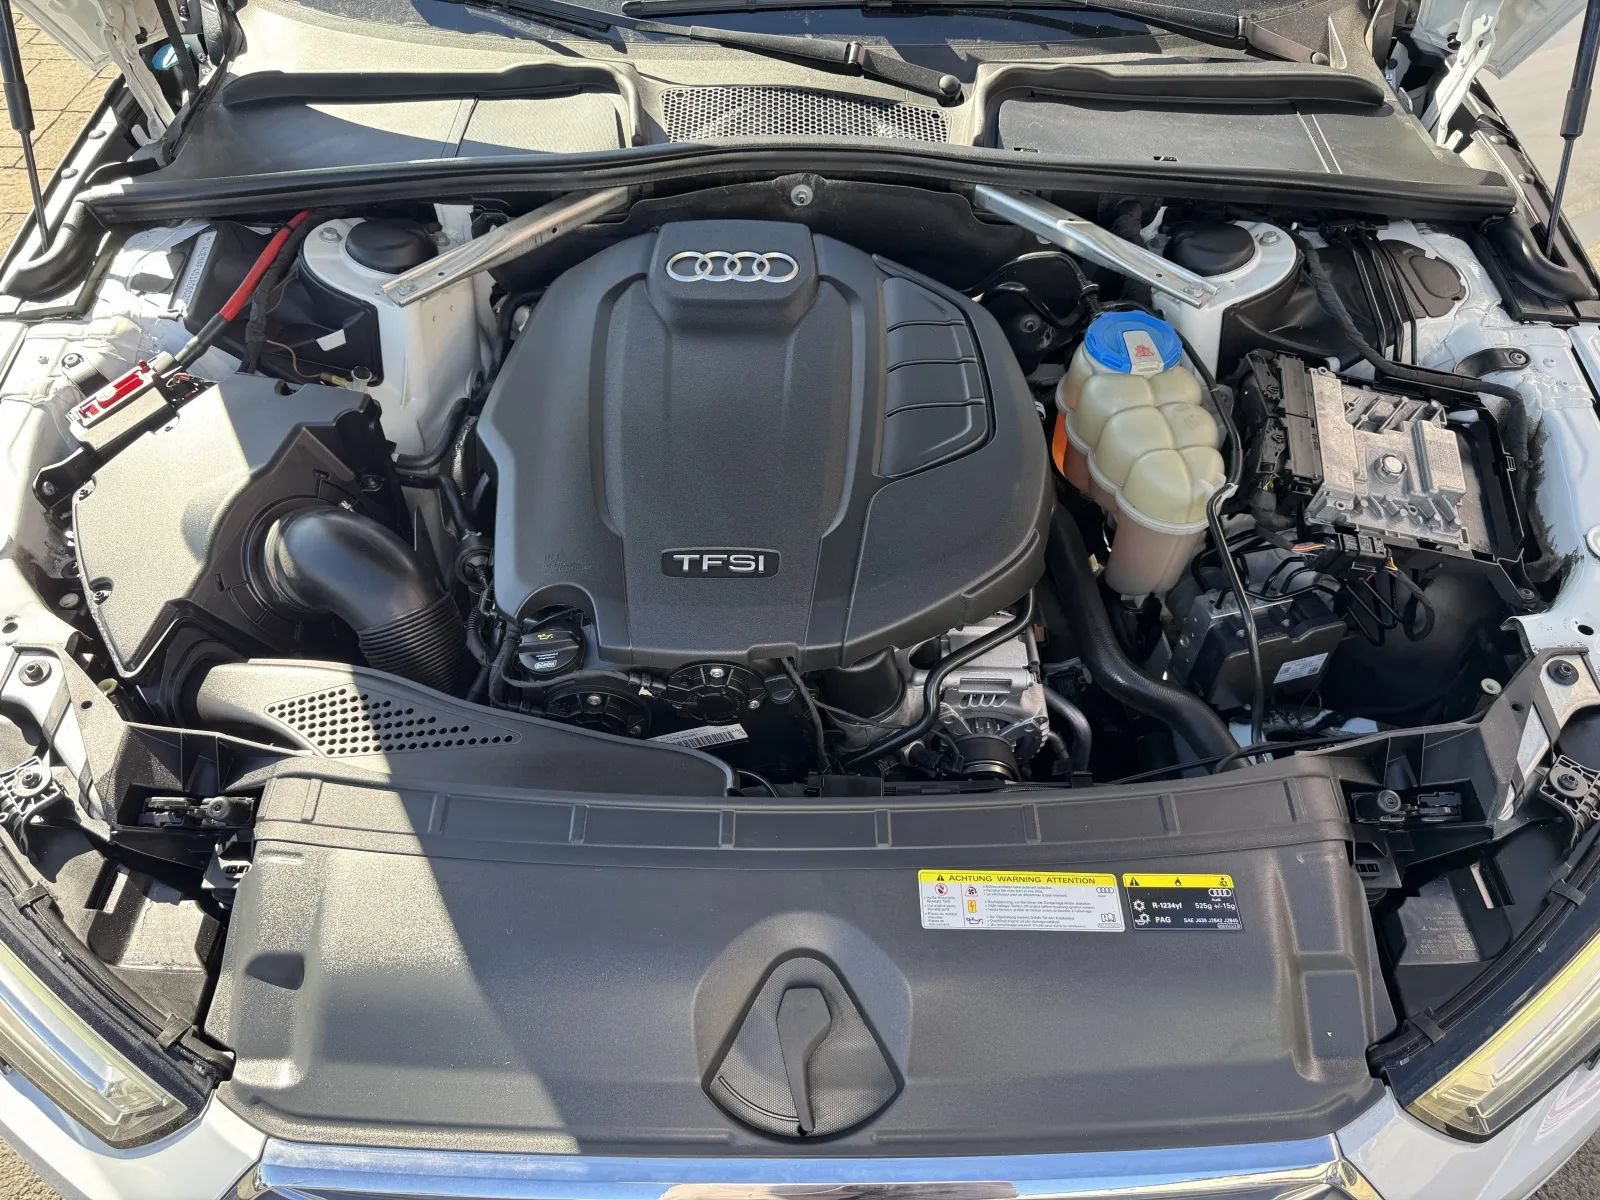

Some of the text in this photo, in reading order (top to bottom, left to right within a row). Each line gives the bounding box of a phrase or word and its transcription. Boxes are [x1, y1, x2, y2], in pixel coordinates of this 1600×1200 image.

[673, 554, 764, 573] TFSI
[948, 874, 993, 882] ACHTUNG
[1046, 877, 1096, 885] ATTENTION
[1152, 902, 1182, 911] R-1234yf
[1194, 902, 1213, 910] 525g
